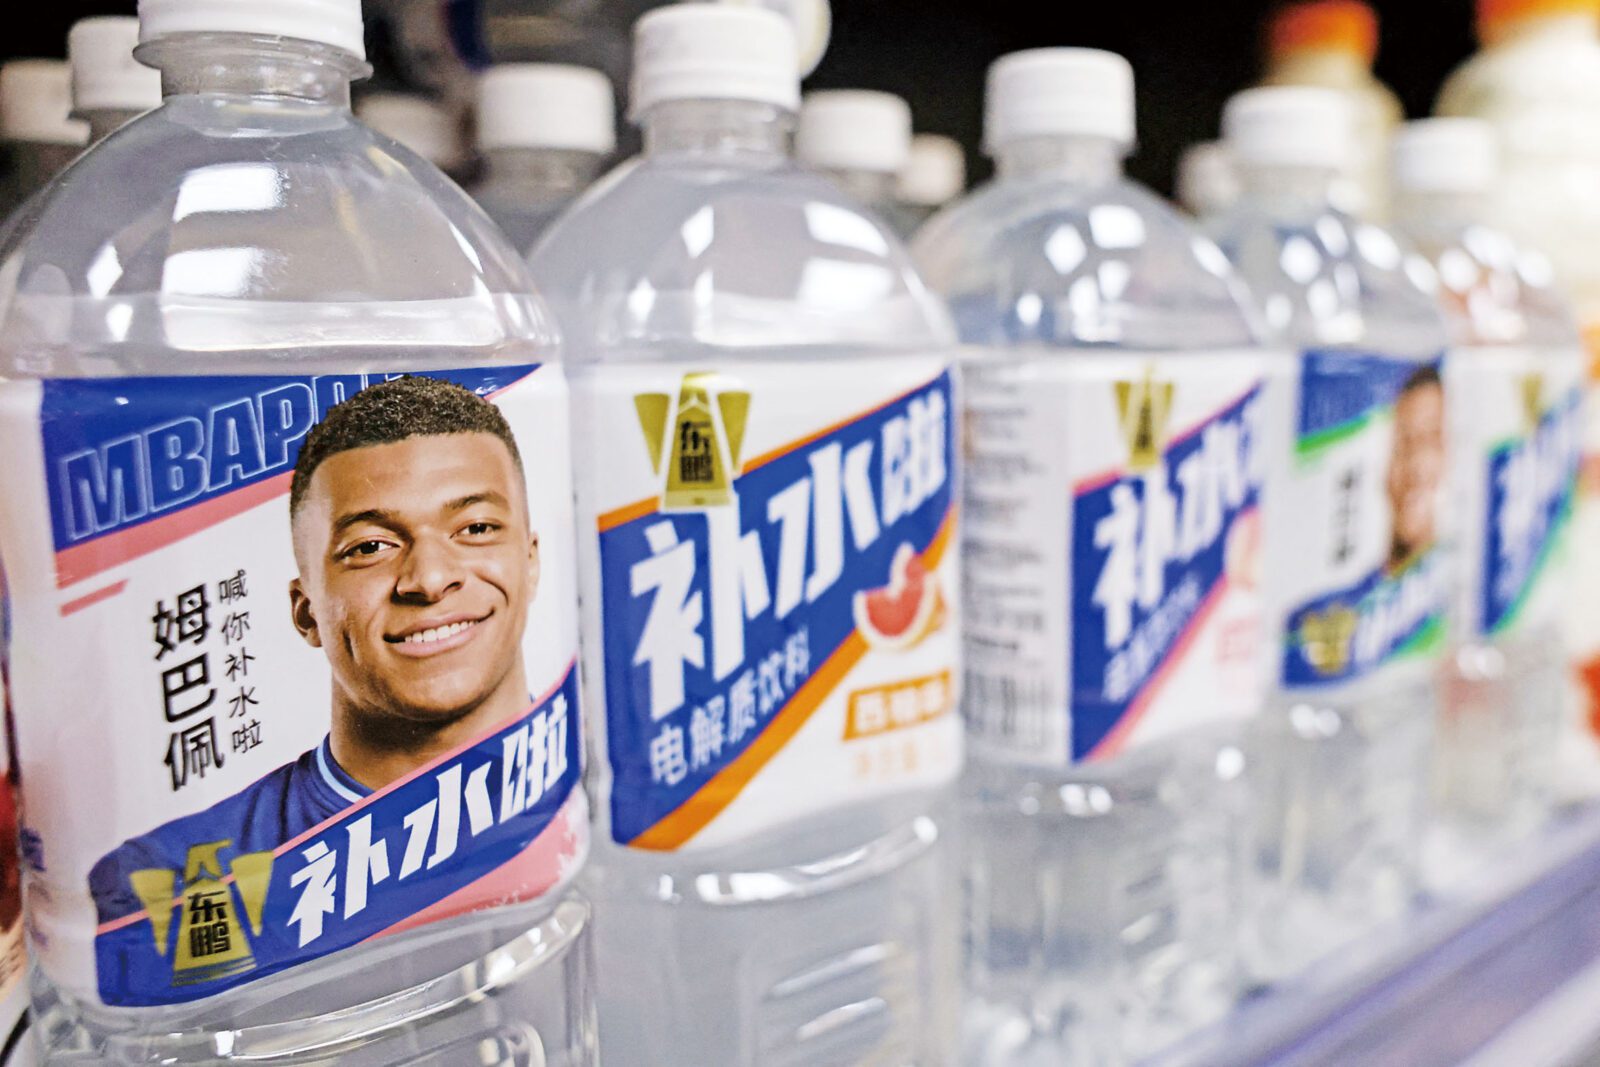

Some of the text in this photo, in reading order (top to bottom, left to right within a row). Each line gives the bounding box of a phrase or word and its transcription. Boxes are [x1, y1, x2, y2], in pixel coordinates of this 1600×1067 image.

[631, 388, 946, 722] 补水啦
[152, 582, 225, 792] 姆巴佩
[218, 569, 263, 754] 喊你补水啦
[187, 890, 230, 958] 东鹏
[286, 699, 568, 949] 补水啦
